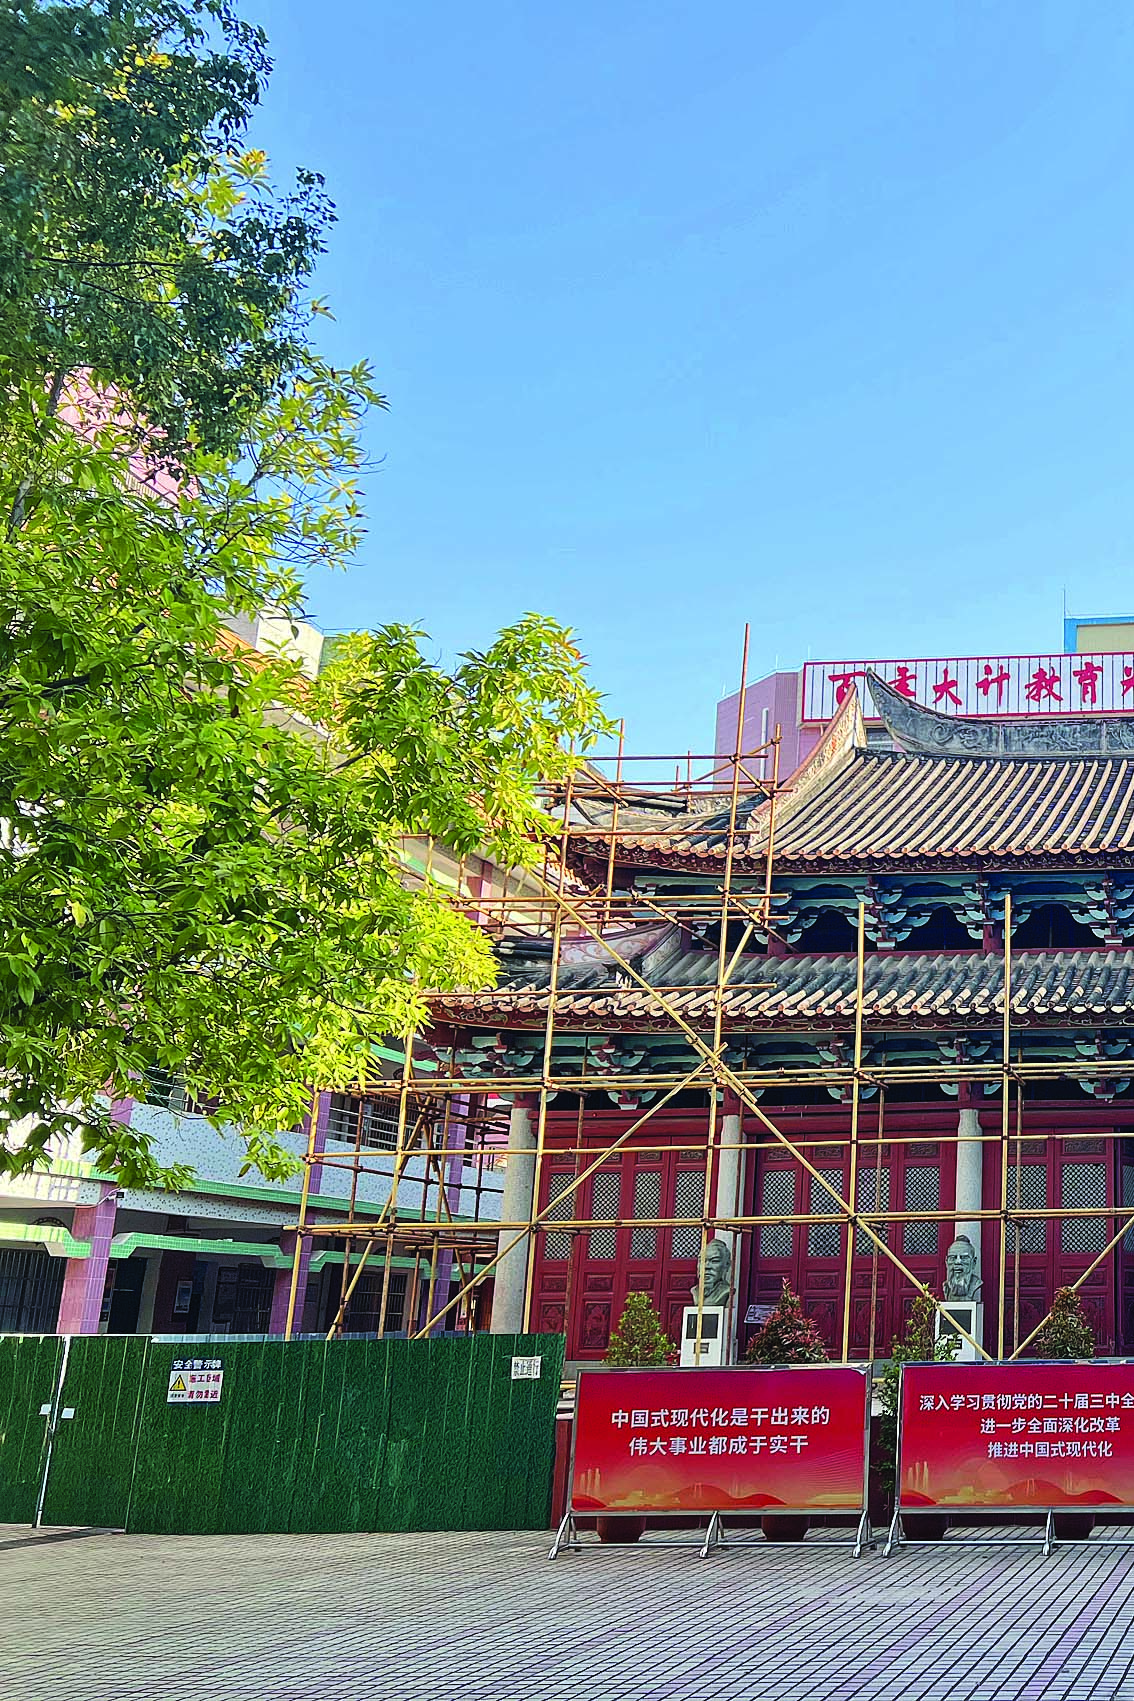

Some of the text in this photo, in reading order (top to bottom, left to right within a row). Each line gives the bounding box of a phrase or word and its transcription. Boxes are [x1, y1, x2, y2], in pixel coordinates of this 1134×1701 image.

[611, 1406, 831, 1428] 中国式现代化是干出来的
[980, 1416, 1121, 1434] 进一步全面深化改革
[629, 1435, 809, 1457] 伟大事业都成于实干
[987, 1440, 1113, 1459] 推进中国式现代化
